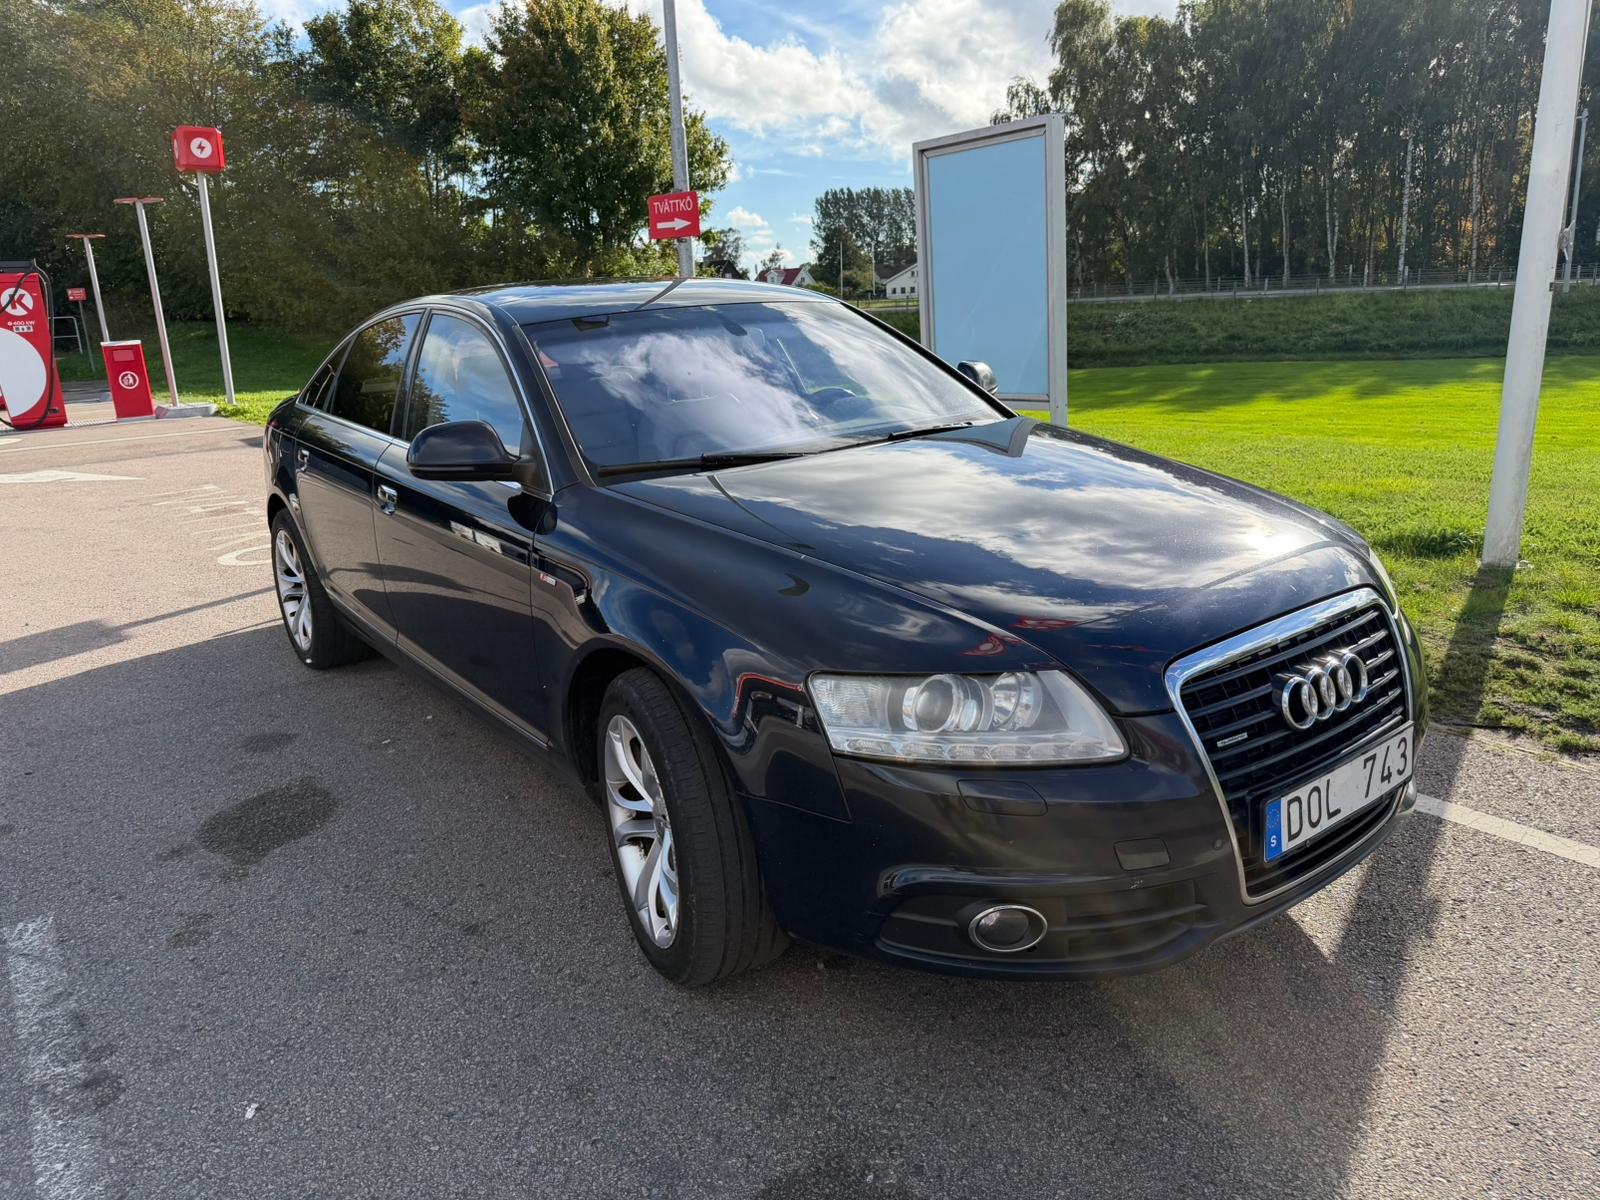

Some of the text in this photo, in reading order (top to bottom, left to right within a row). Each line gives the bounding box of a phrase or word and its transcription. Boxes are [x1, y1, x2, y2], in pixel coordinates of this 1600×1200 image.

[653, 196, 693, 214] TVÄTTKÖ
[1287, 736, 1408, 843] DOL 743
[1270, 835, 1277, 847] S
